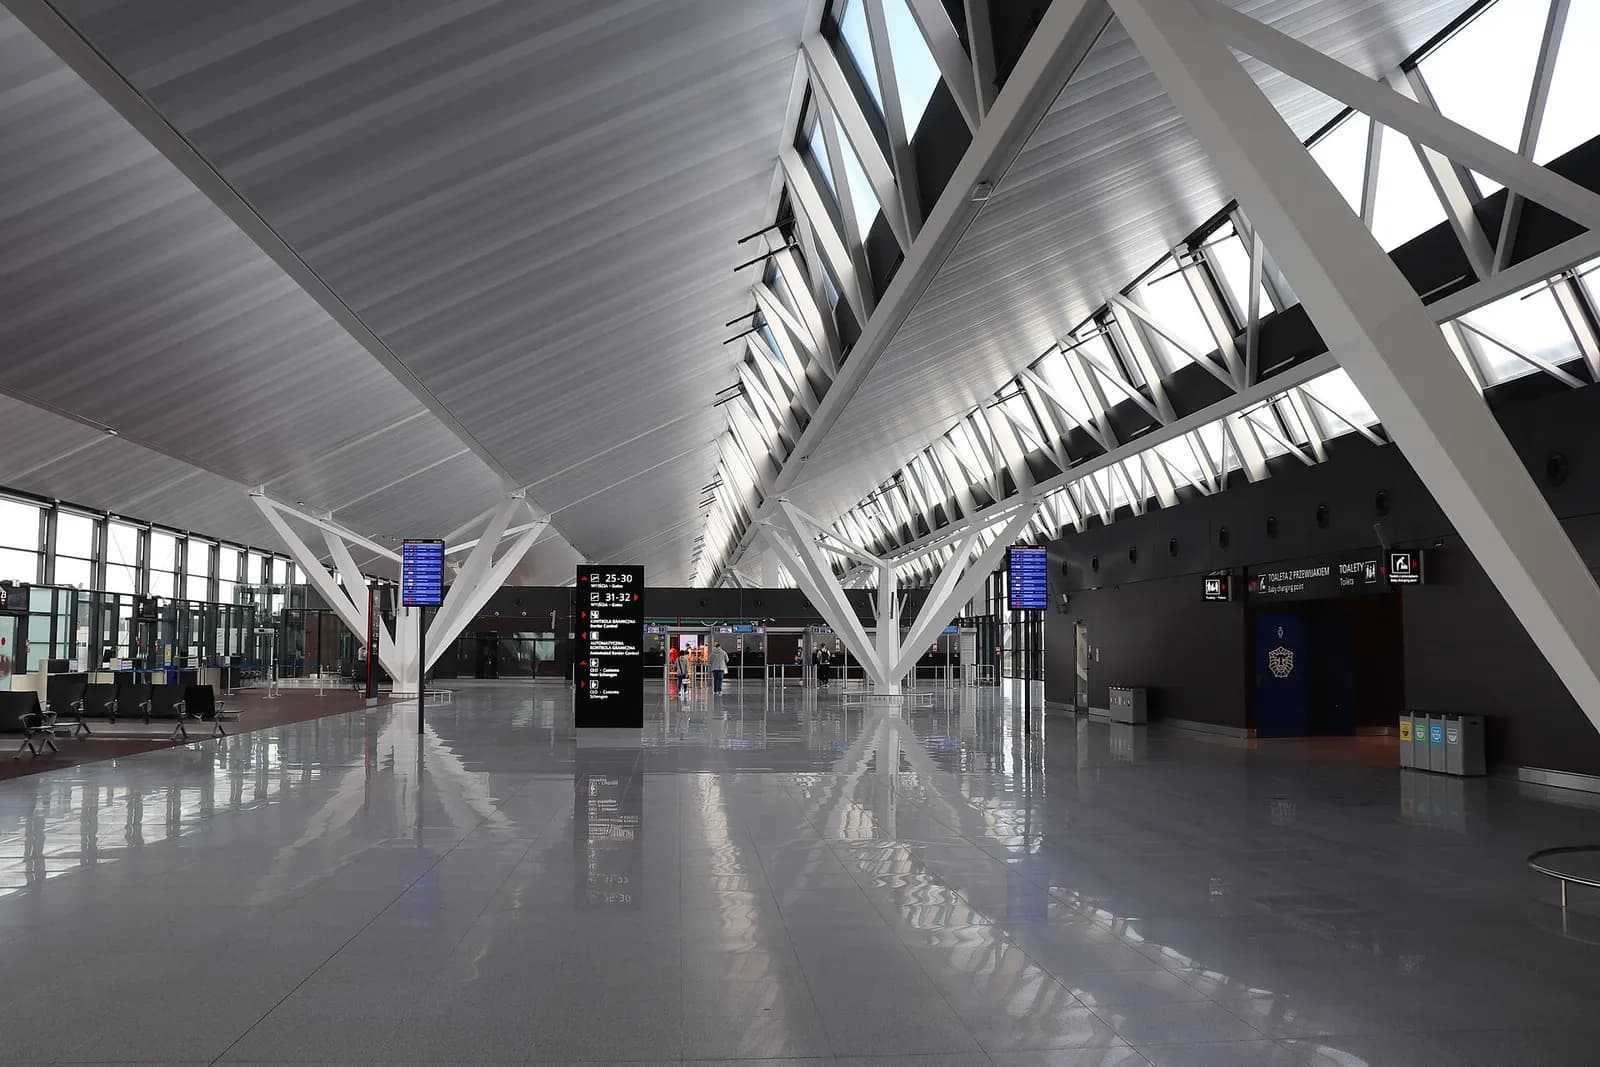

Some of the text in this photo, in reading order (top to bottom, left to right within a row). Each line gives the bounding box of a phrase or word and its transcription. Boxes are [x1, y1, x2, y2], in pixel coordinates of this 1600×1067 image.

[1339, 562, 1364, 573] TOALETY
[605, 573, 633, 583] 25-30
[1268, 571, 1288, 582] TOALETA
[605, 592, 631, 602] 31-32
